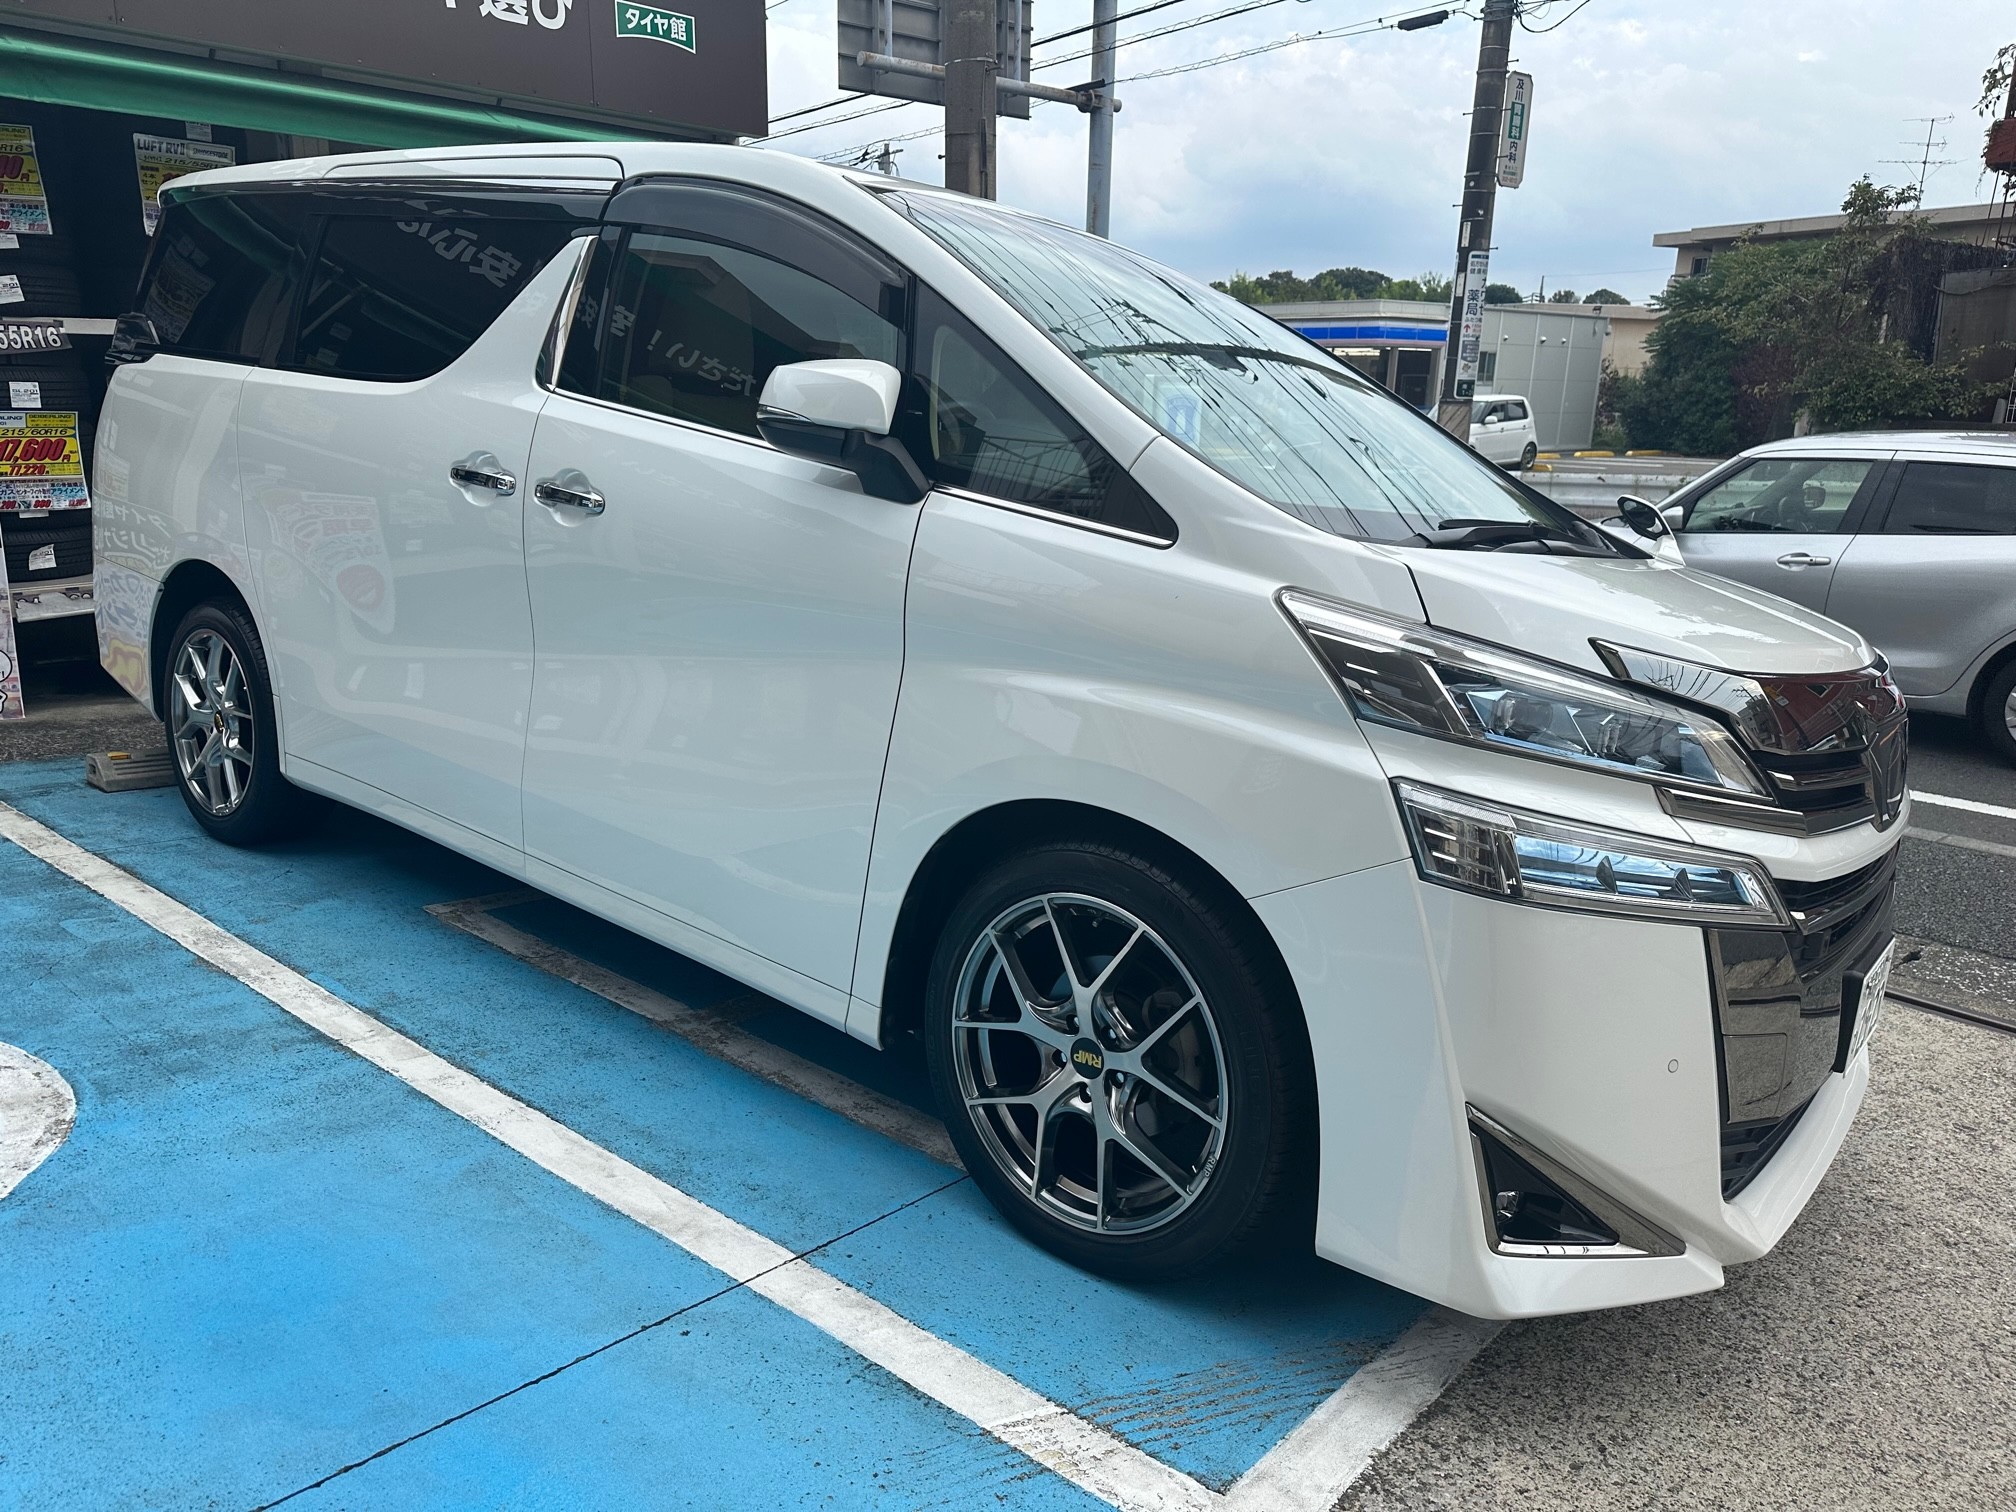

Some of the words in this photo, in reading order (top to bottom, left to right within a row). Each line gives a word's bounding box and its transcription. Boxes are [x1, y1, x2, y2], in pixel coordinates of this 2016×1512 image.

[625, 8, 687, 41] タイヤ館
[137, 138, 164, 152] LUFT
[1, 428, 68, 436] 215/60R16
[51, 487, 84, 495] アライメント
[1073, 1049, 1102, 1068] RMP
[1203, 1155, 1216, 1177] RMP
